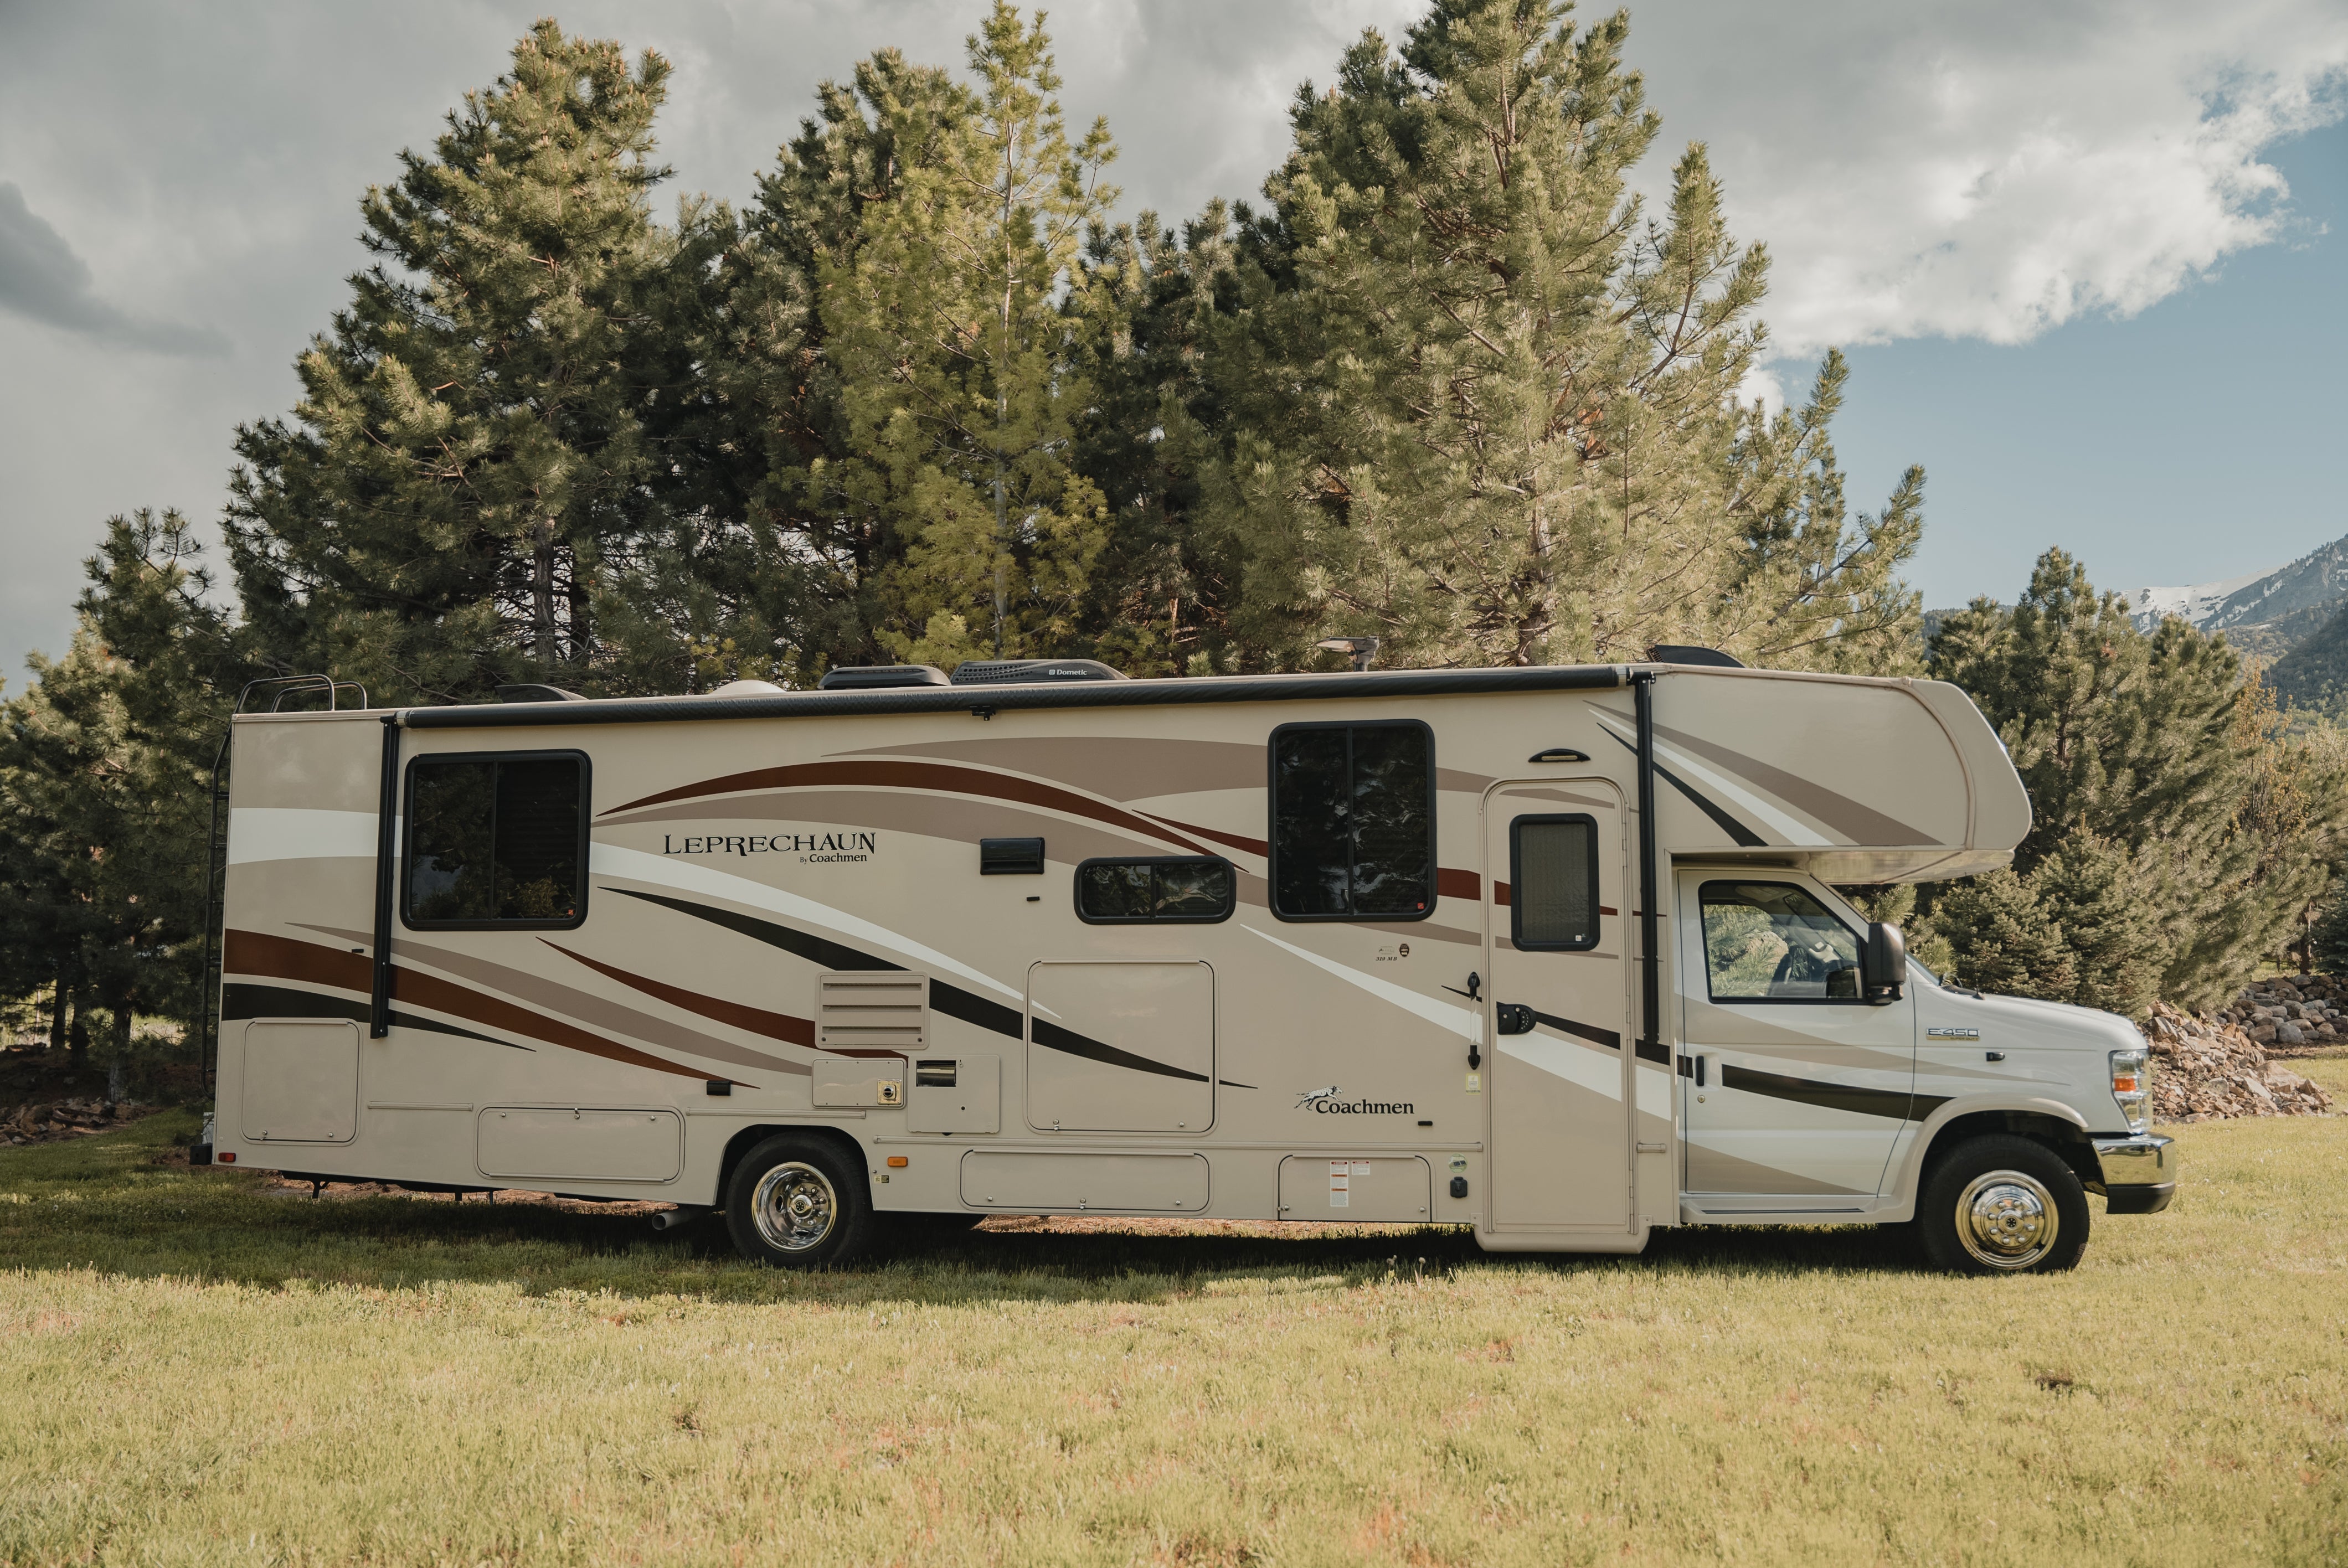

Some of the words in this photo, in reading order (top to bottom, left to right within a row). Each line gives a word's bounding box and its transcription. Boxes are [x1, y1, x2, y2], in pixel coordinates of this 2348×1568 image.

[663, 832, 876, 857] LEPRECHAUN
[800, 856, 809, 865] By
[809, 853, 868, 863] Coachmen
[1315, 1098, 1415, 1114] Coachmen
